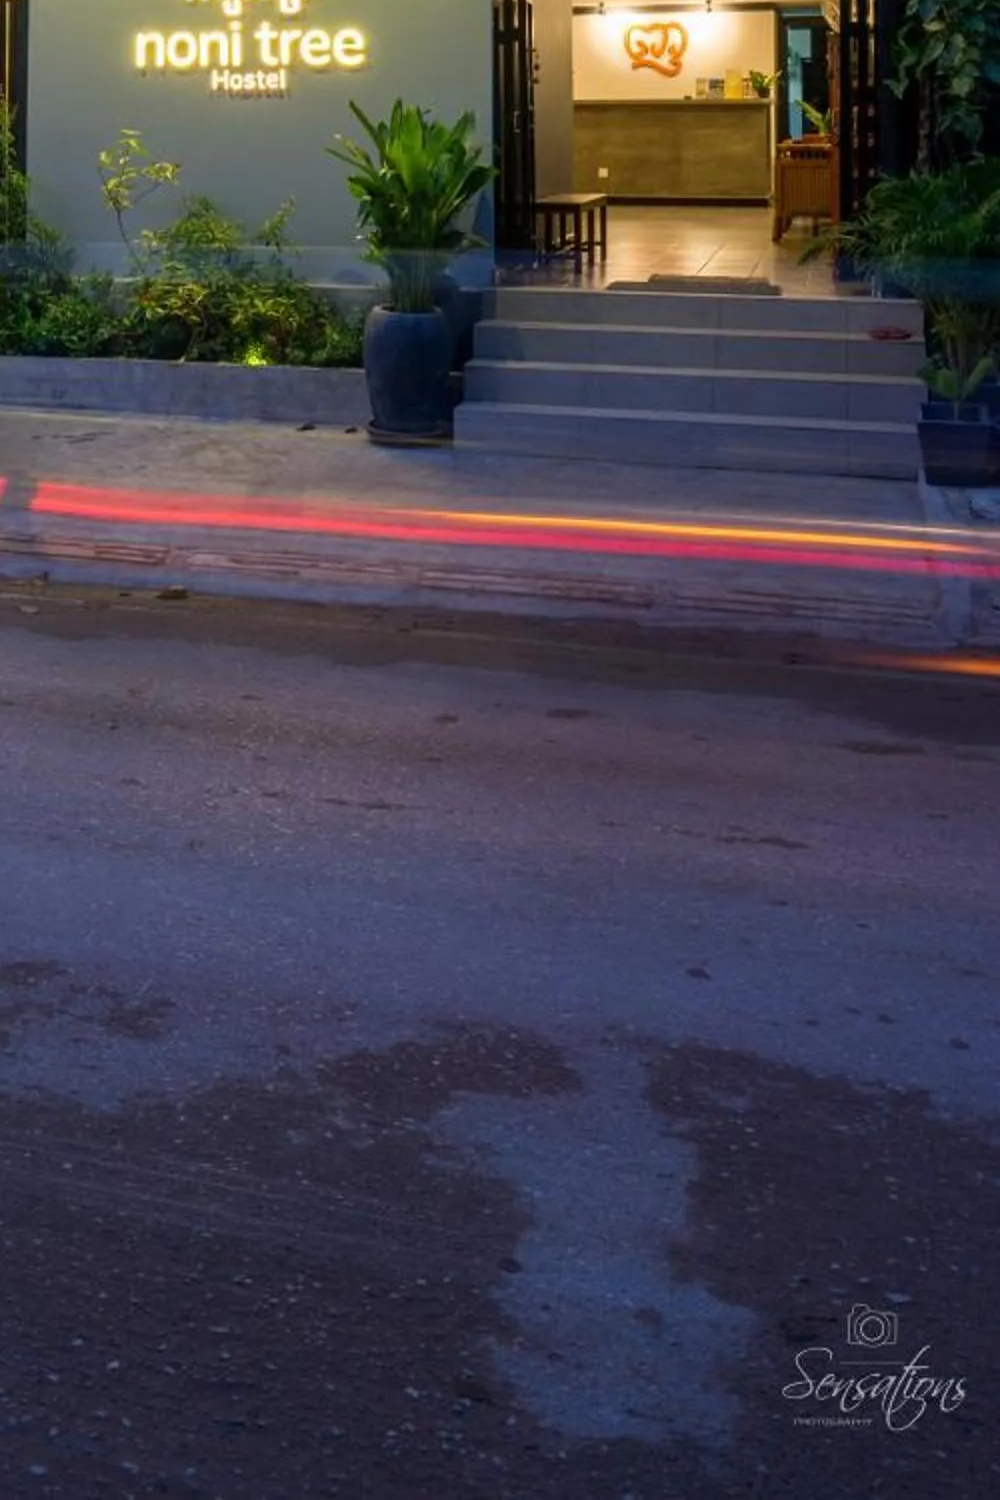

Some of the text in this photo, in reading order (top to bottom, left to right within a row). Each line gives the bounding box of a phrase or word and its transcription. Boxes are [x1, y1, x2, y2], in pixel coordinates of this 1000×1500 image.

[134, 19, 368, 69] noni tree
[210, 68, 288, 91] Hostel
